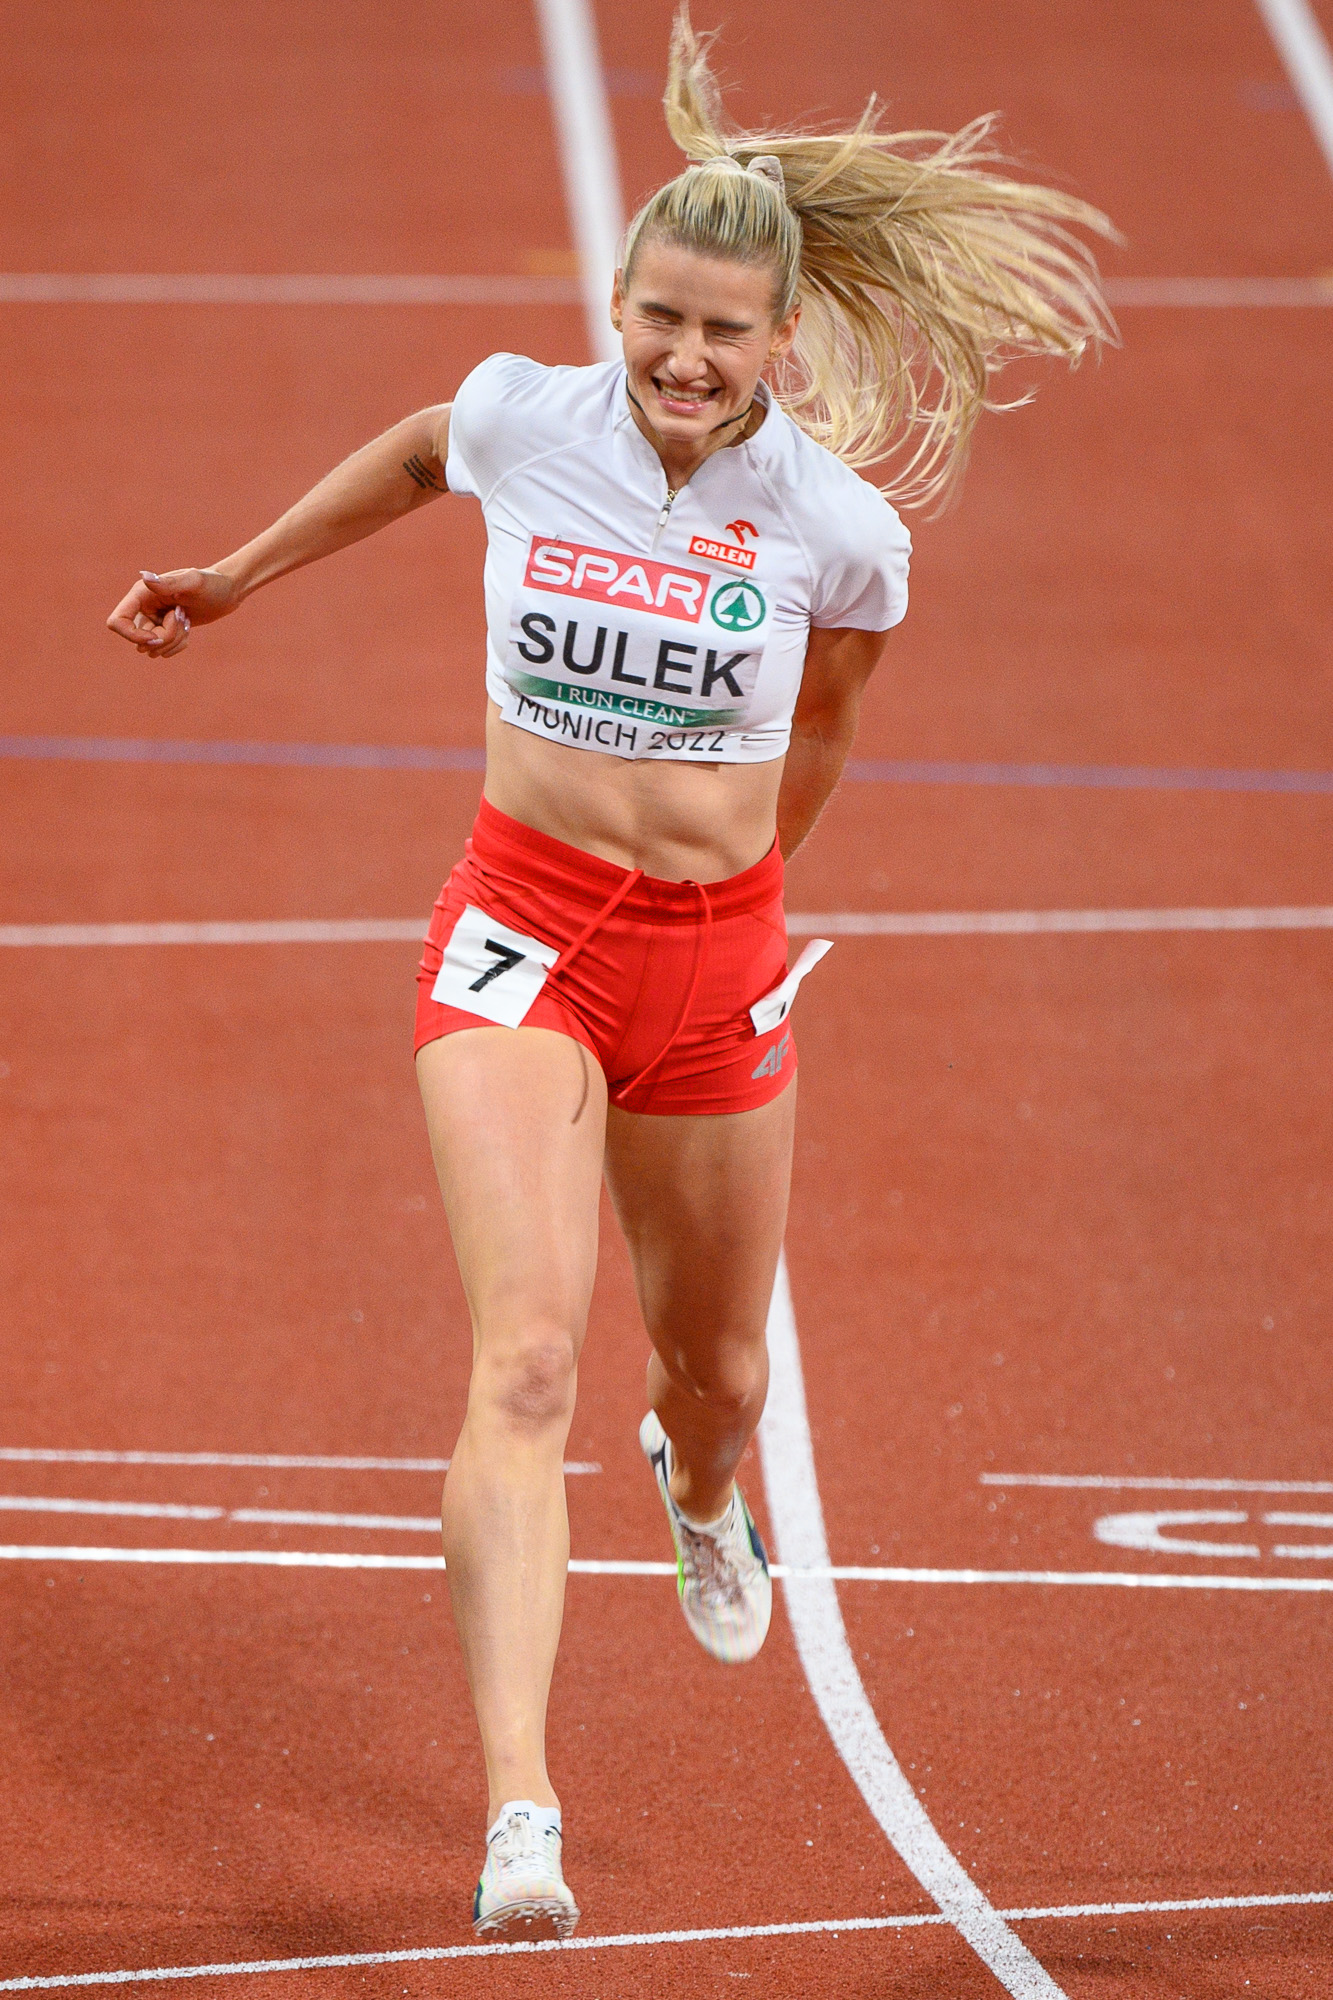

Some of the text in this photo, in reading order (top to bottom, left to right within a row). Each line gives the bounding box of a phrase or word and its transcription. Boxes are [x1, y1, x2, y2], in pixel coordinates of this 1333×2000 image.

[530, 545, 703, 616] SPAR
[693, 539, 752, 567] ORLEN
[517, 612, 751, 698] SULEK
[516, 694, 726, 752] MUNICH 2022
[557, 684, 563, 699] I
[569, 687, 614, 710] RUN
[467, 938, 527, 993] 7
[751, 1029, 790, 1080] 4F
